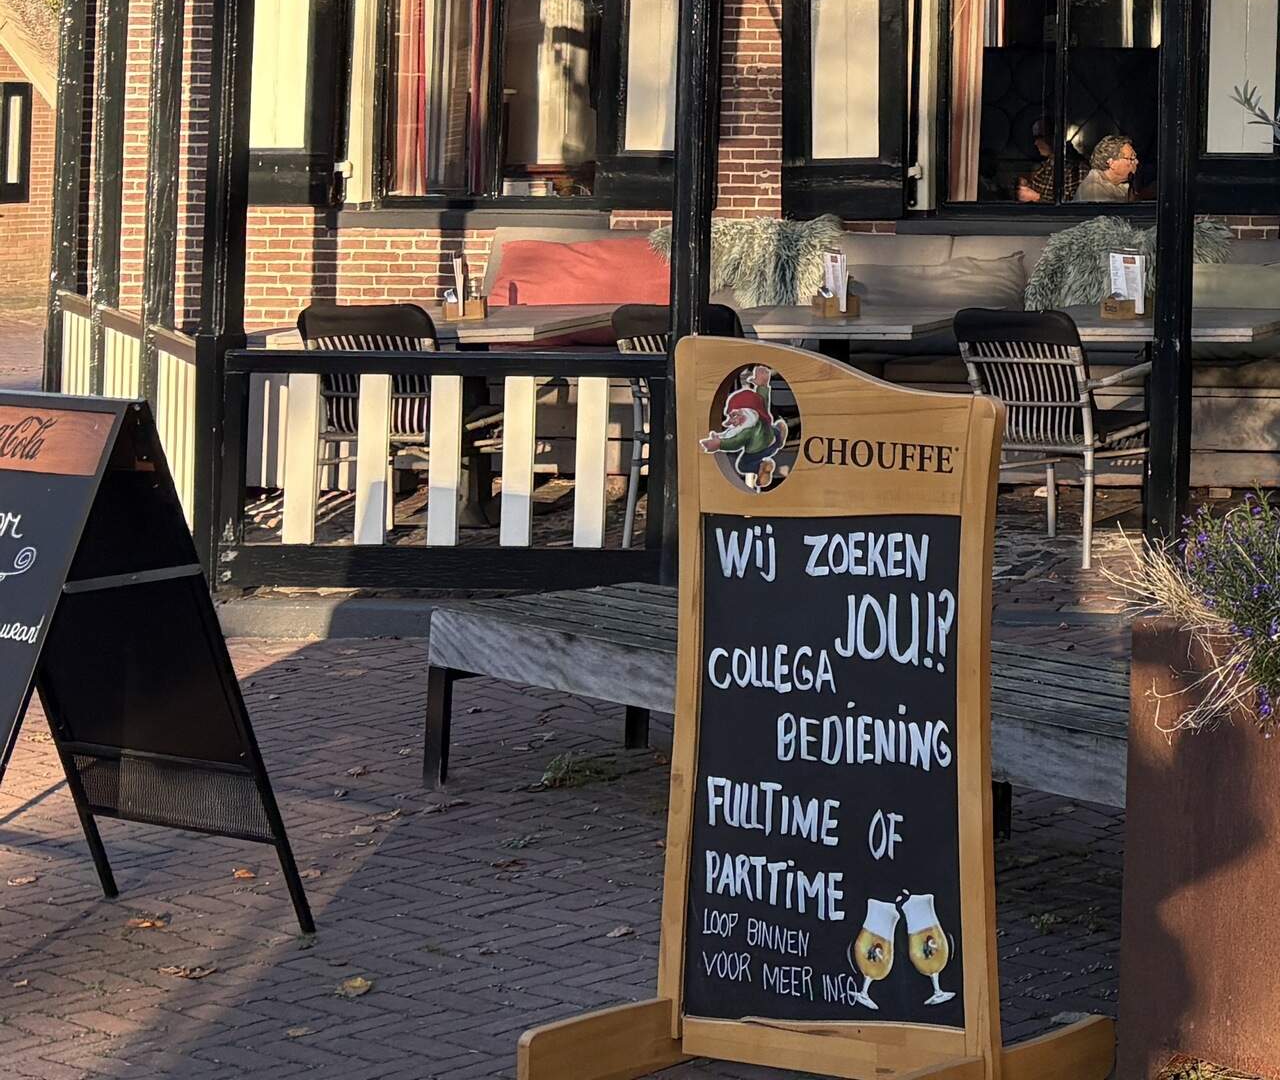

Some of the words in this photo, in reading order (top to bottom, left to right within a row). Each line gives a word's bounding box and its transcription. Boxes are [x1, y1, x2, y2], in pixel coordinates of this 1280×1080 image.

[803, 435, 955, 474] CHOUFFE
[803, 531, 930, 582] ZOEKEN
[708, 644, 837, 694] COLLEGA
[706, 775, 841, 847] FULLTIME
[868, 808, 904, 861] OF
[702, 907, 739, 939] LOOP
[746, 917, 810, 958] BINNEN
[702, 949, 752, 983] VOOR
[762, 962, 814, 1001] MEER
